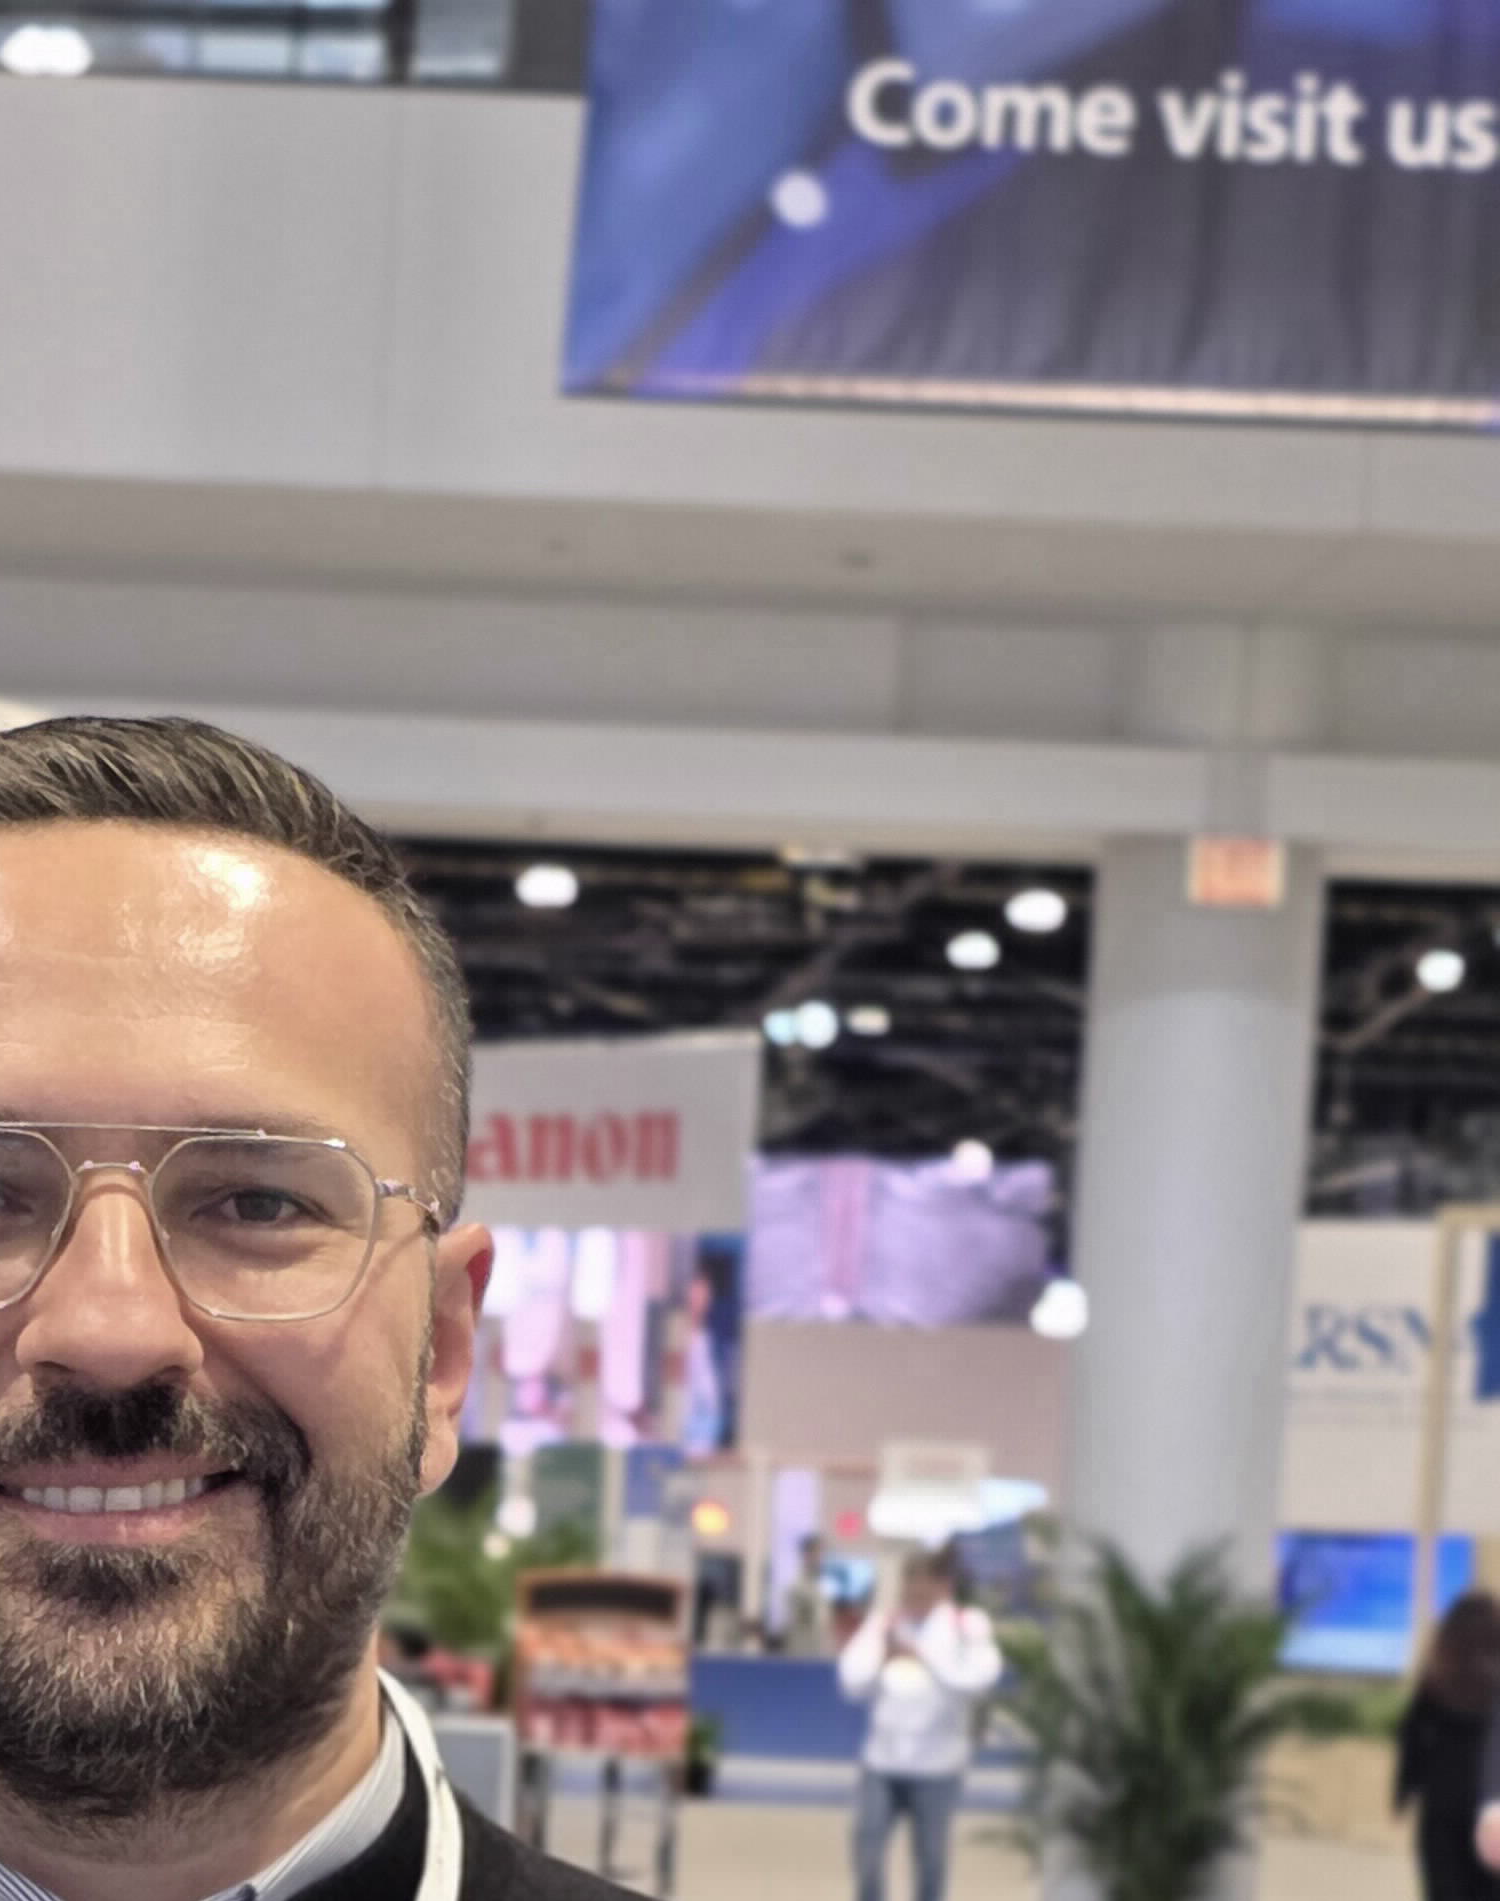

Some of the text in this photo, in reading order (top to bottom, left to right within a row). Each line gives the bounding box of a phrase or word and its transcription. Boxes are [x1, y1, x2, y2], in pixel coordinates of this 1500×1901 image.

[848, 58, 1496, 170] Come visit us
[467, 1110, 680, 1184] anon
